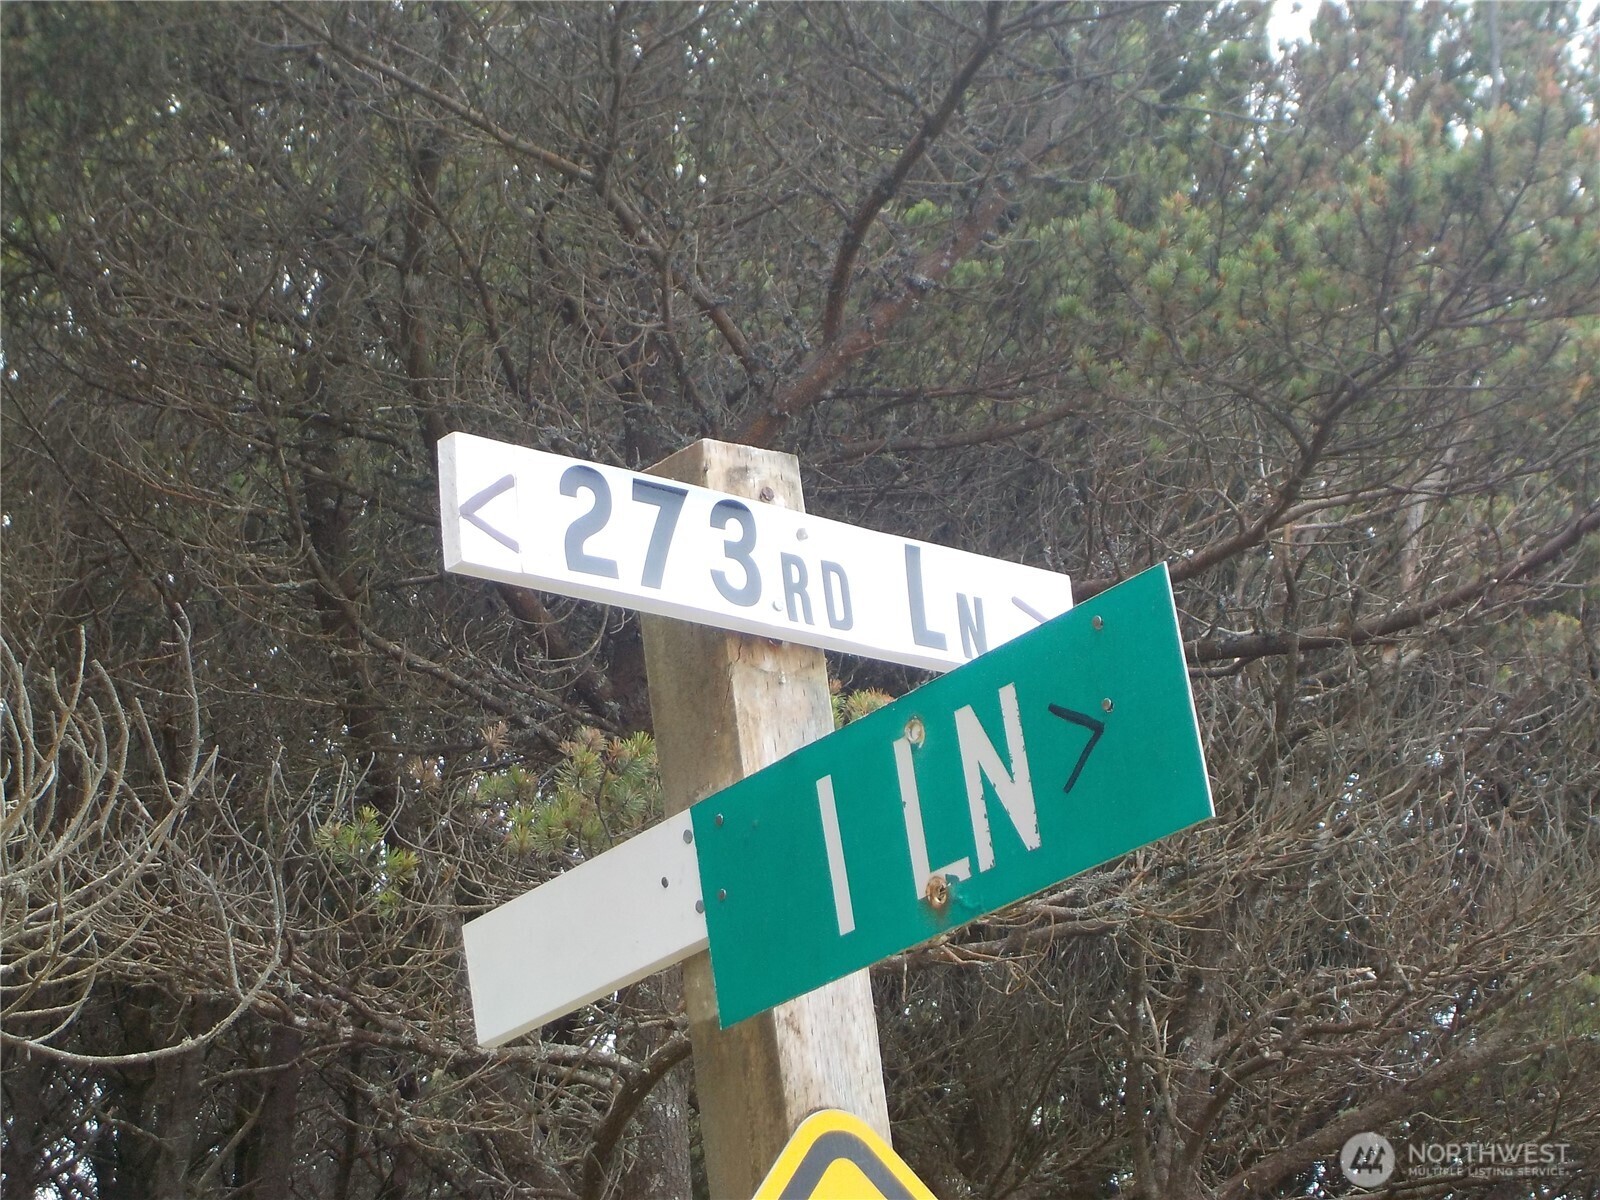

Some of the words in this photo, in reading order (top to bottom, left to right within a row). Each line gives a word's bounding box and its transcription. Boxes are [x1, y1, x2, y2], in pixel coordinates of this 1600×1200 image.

[559, 465, 853, 631] 273RD
[816, 774, 856, 936] I
[893, 682, 1041, 899] LN
